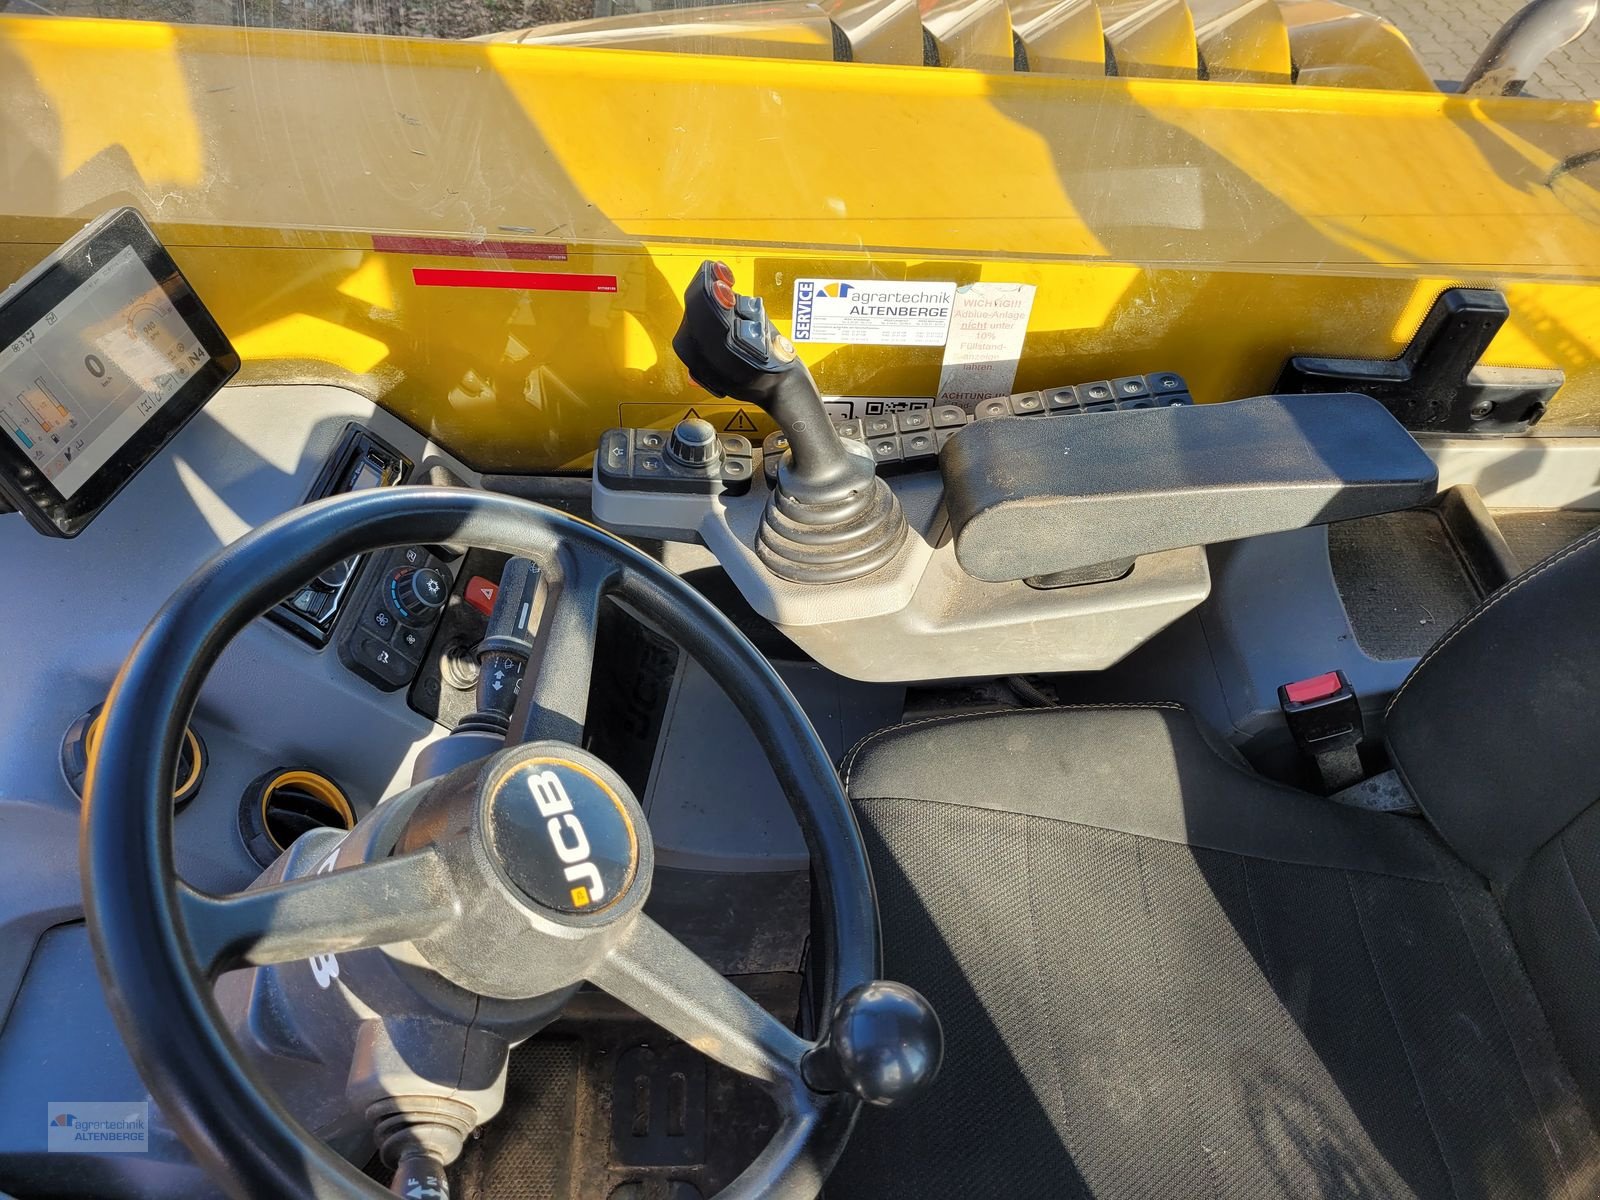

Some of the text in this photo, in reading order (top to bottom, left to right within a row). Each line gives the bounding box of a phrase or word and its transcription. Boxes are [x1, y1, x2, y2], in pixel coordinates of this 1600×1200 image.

[851, 288, 950, 304] agrartechnik
[795, 282, 814, 339] SERVICE
[849, 305, 949, 317] ALTENBERGE
[954, 310, 1025, 320] Adblue-Anlage
[961, 321, 988, 330] nicht
[976, 332, 996, 340] 10%
[960, 341, 1008, 351] Füllstand-
[188, 347, 205, 366] N4
[84, 354, 105, 378] 0
[941, 392, 995, 400] ACHTUNG
[527, 770, 605, 903] JCB
[407, 1177, 419, 1186] F
[426, 1176, 437, 1185] N
